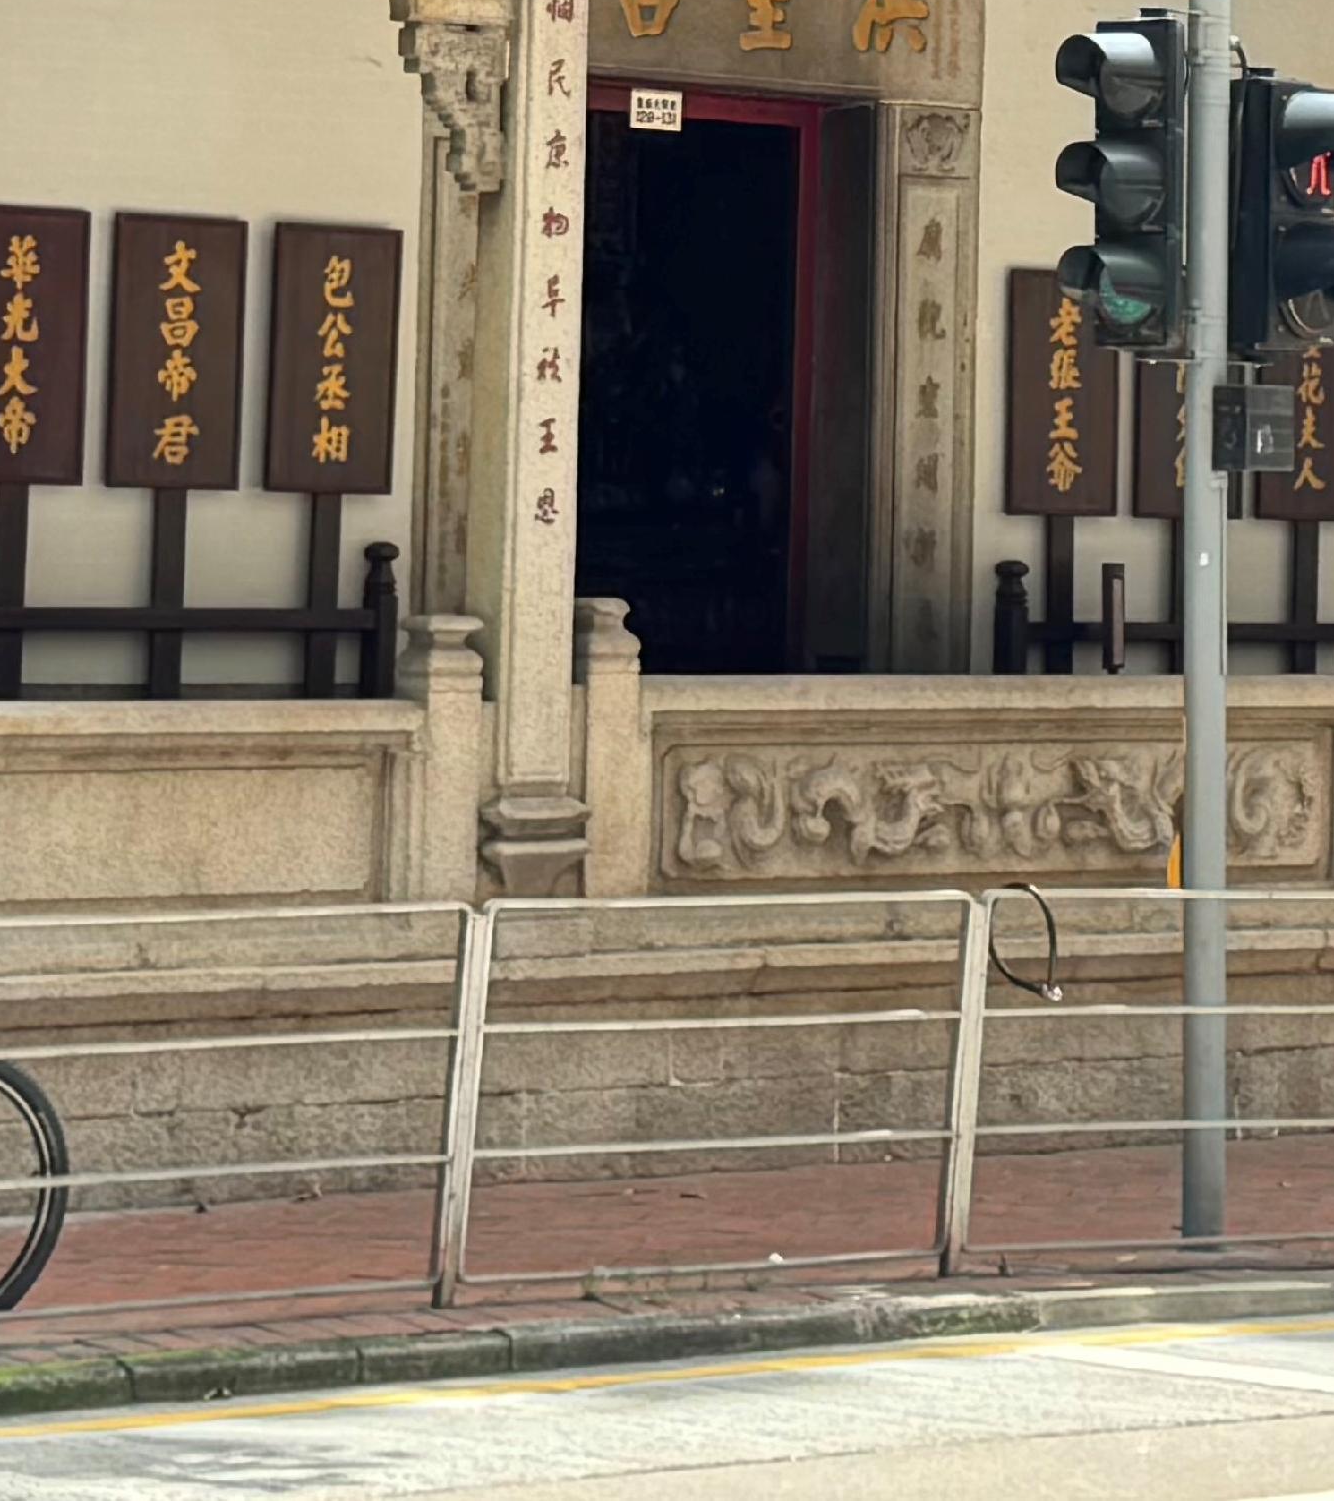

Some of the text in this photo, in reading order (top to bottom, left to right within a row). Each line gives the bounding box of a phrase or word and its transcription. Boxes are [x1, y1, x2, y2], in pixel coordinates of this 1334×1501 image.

[151, 239, 202, 466] 文昌帝君
[310, 254, 355, 465] 包公丞相
